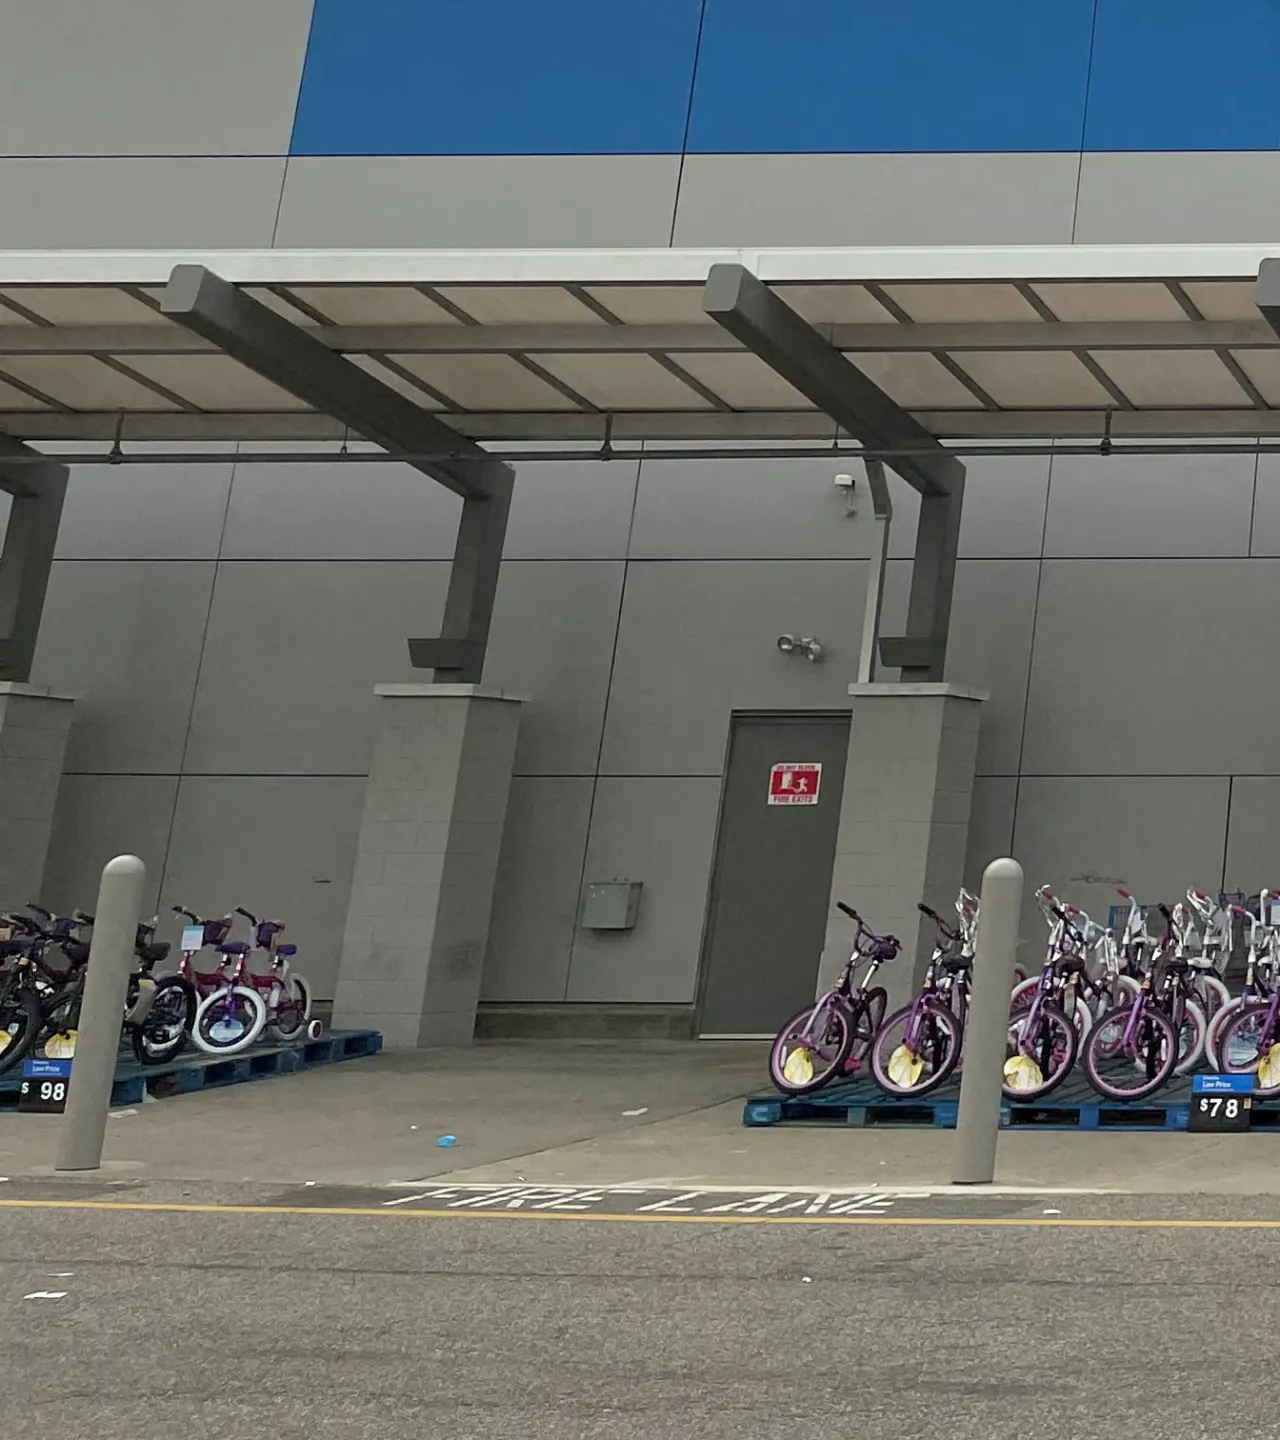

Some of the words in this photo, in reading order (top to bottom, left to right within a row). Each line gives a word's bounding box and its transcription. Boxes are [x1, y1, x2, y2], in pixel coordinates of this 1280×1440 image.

[1200, 1098, 1238, 1118] $78
[381, 1186, 647, 1209] FIRE
[634, 1191, 931, 1214] LANE
